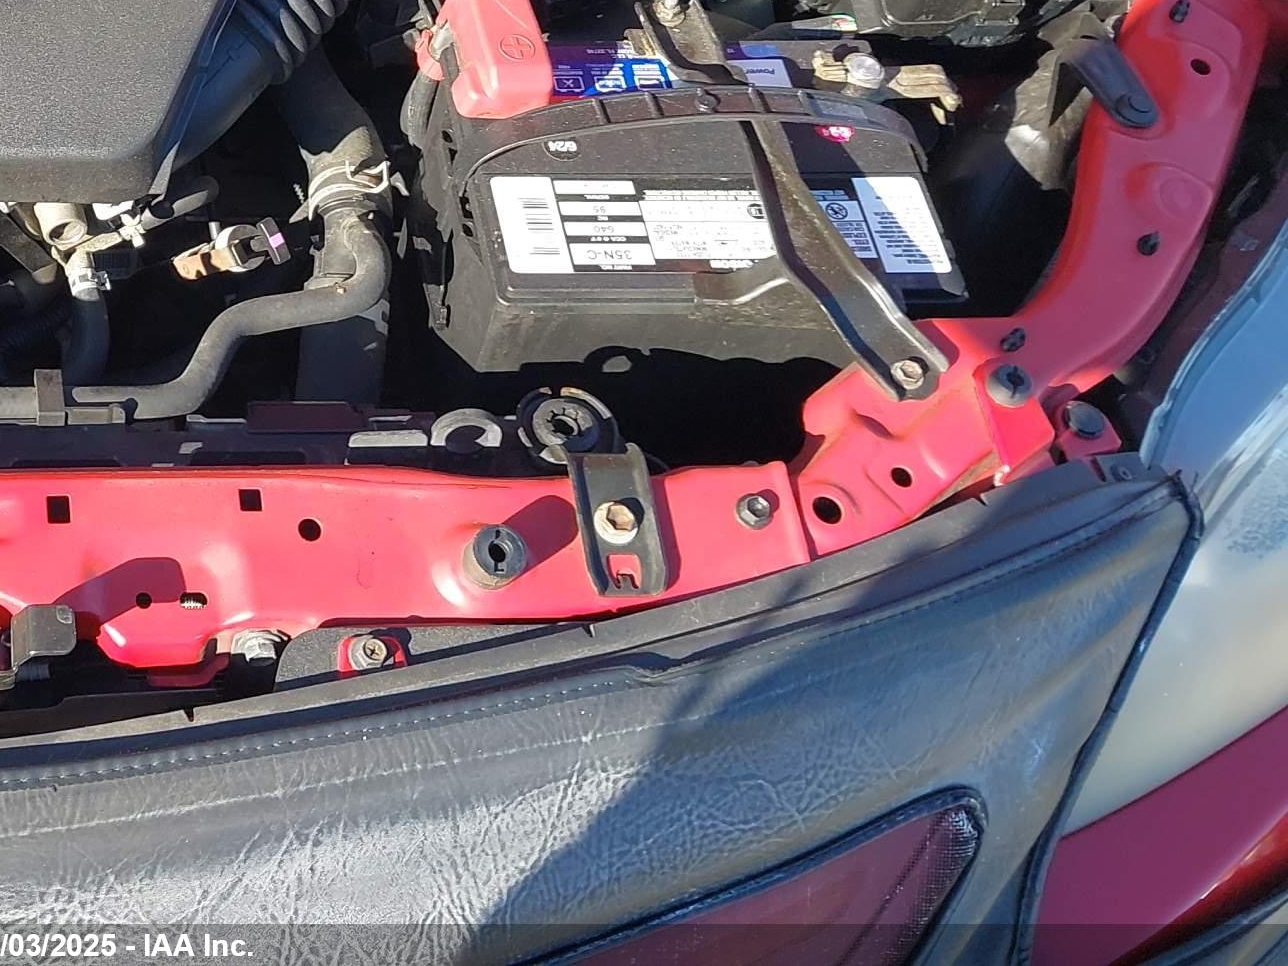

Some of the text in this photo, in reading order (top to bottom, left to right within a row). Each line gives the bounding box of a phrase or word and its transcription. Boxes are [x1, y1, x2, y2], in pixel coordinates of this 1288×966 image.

[745, 68, 776, 76] Power
[593, 225, 615, 233] 640
[586, 249, 633, 260] 35N-C
